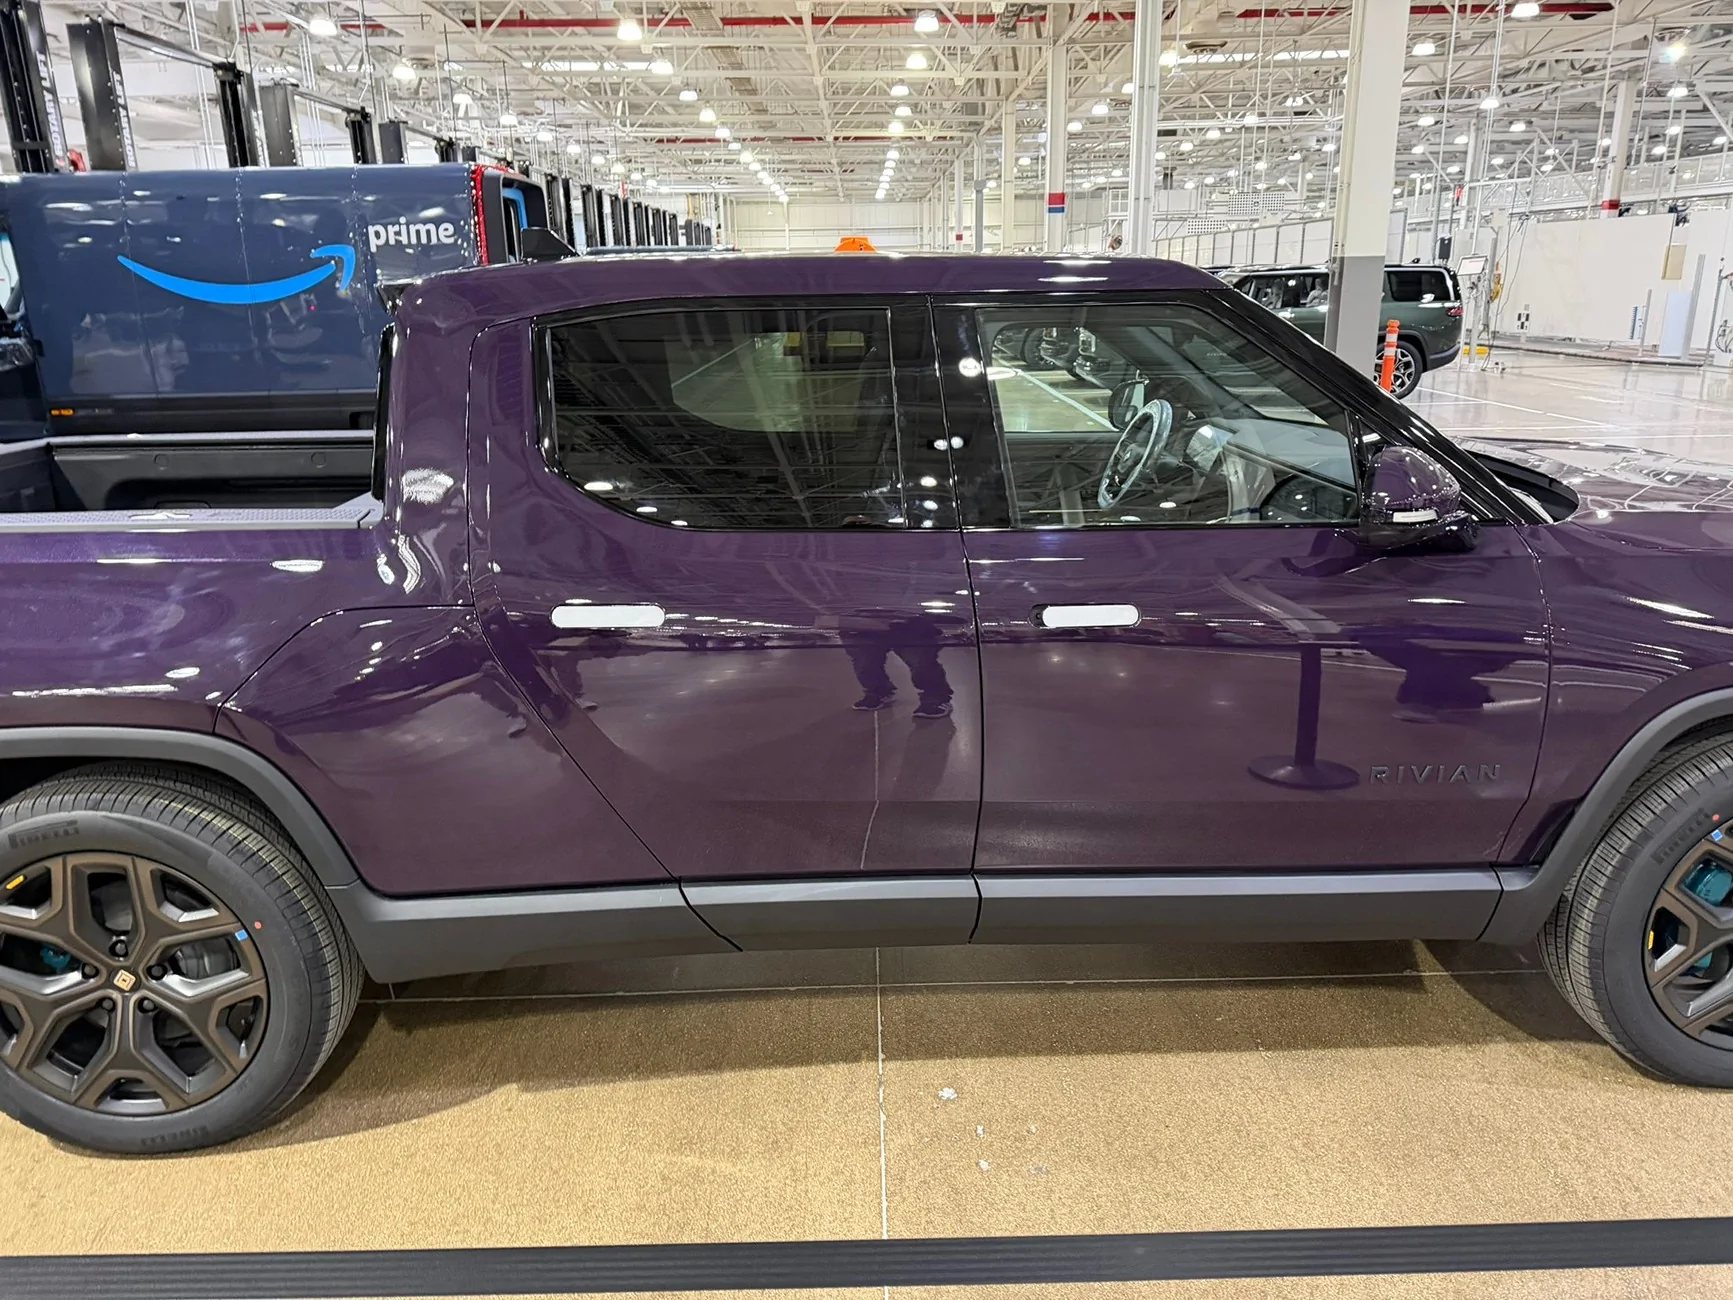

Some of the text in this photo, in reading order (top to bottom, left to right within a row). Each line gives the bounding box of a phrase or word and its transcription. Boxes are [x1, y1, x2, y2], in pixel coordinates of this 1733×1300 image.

[35, 50, 63, 158] ROTARY LIFT
[112, 71, 125, 105] LIFT
[367, 216, 455, 253] prime
[1369, 765, 1500, 784] RIVIAN
